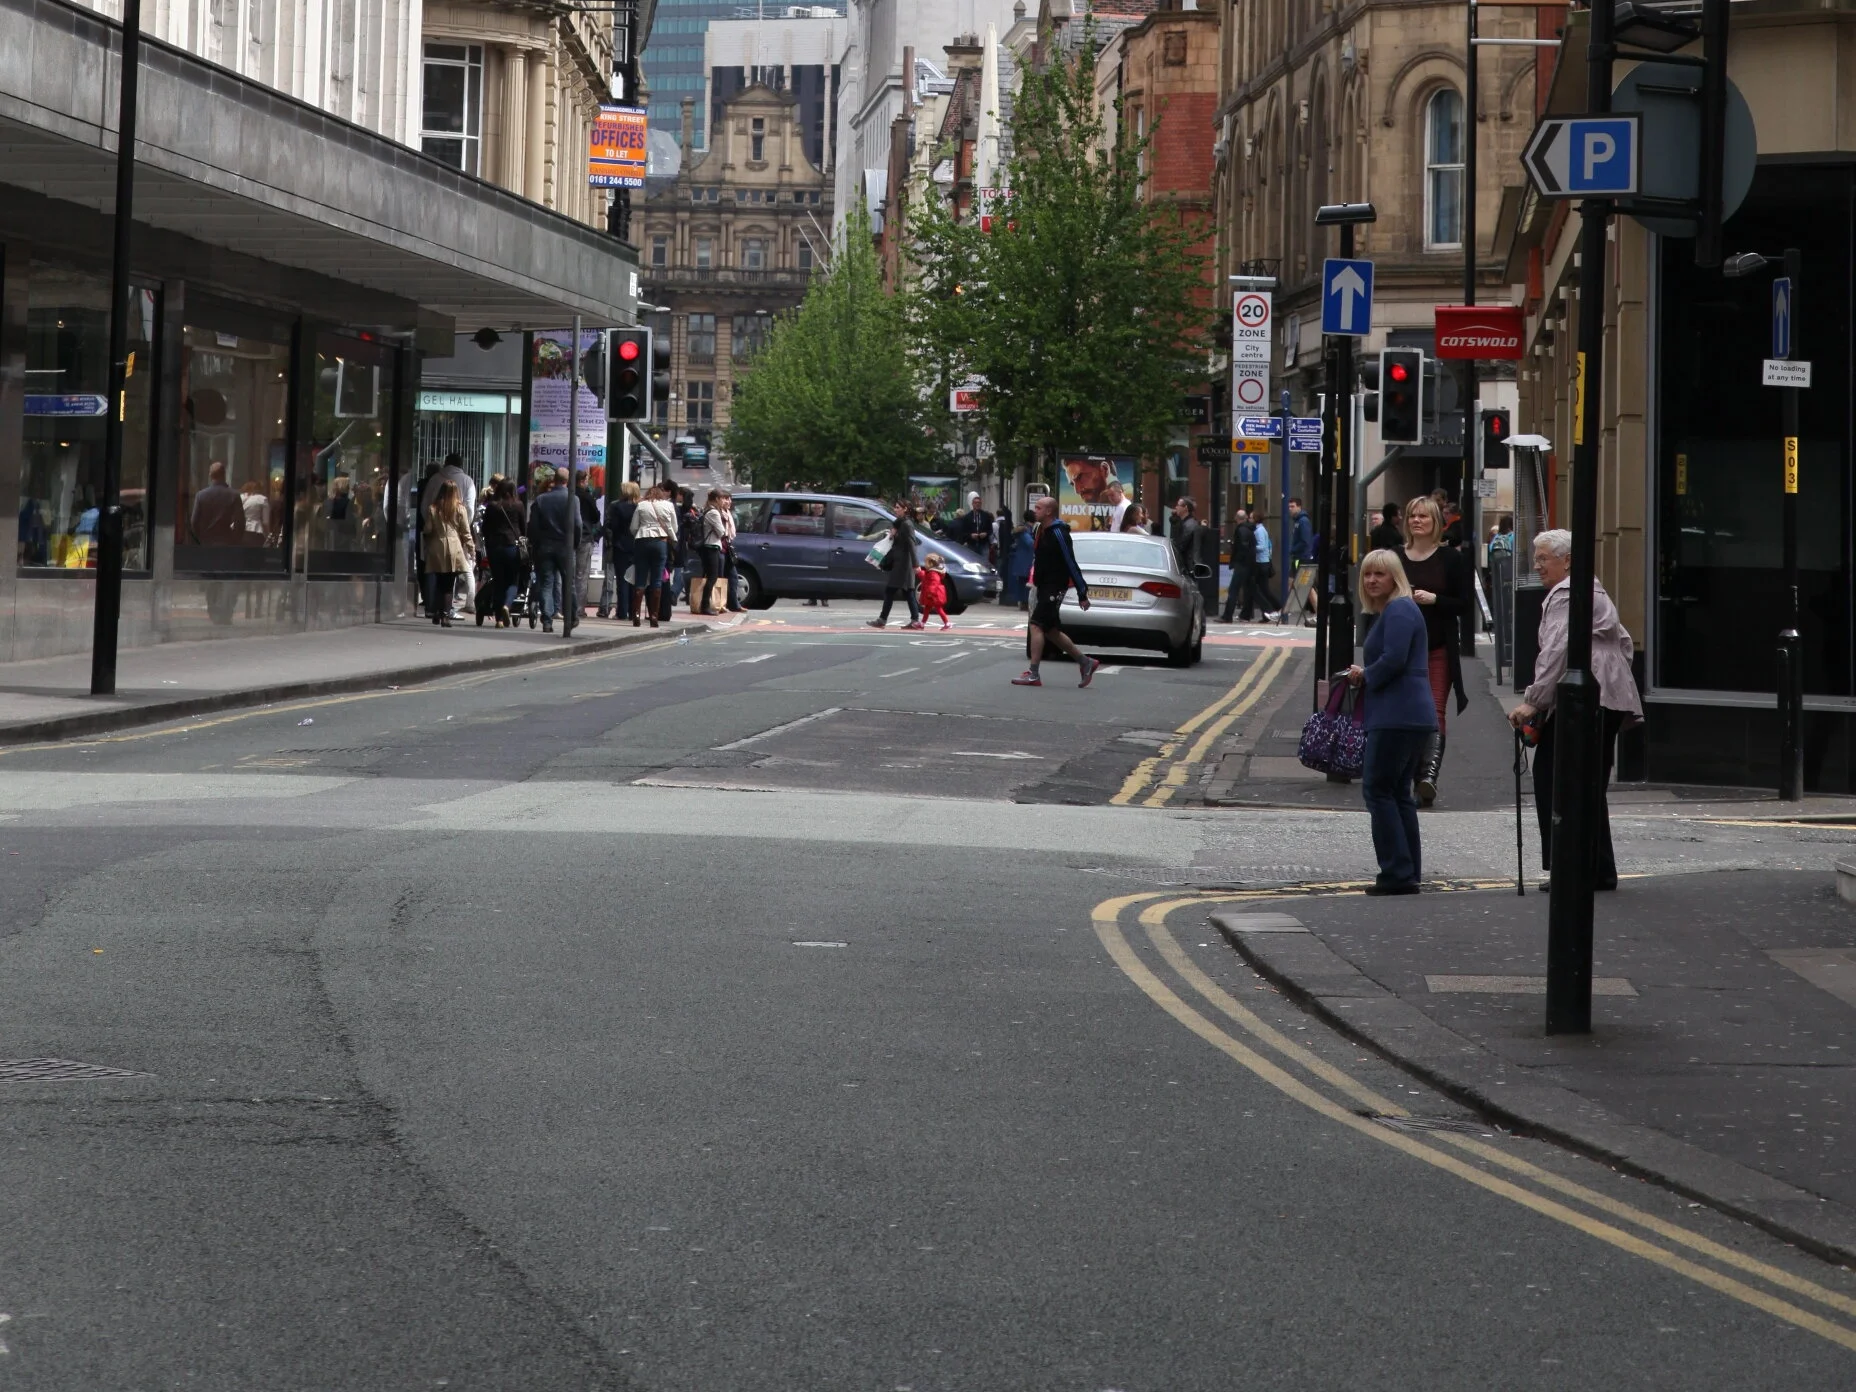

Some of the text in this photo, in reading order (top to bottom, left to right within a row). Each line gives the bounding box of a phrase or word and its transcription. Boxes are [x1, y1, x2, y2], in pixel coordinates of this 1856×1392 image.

[619, 115, 644, 124] STREET
[591, 129, 644, 149] OFFICES
[605, 149, 629, 159] TO LET
[1583, 132, 1616, 180] P
[589, 175, 642, 187] 0161 244 5500
[1241, 304, 1264, 318] 20
[1239, 329, 1266, 338] ZONE
[1440, 336, 1518, 347] COTSWOLD
[1245, 344, 1260, 352] City
[1239, 370, 1264, 378] ZONE
[1780, 365, 1806, 373] loading
[449, 395, 474, 407] HALL
[540, 446, 603, 457] Euroctured
[1787, 440, 1796, 484] S03
[1061, 504, 1118, 517] MAX PAYN
